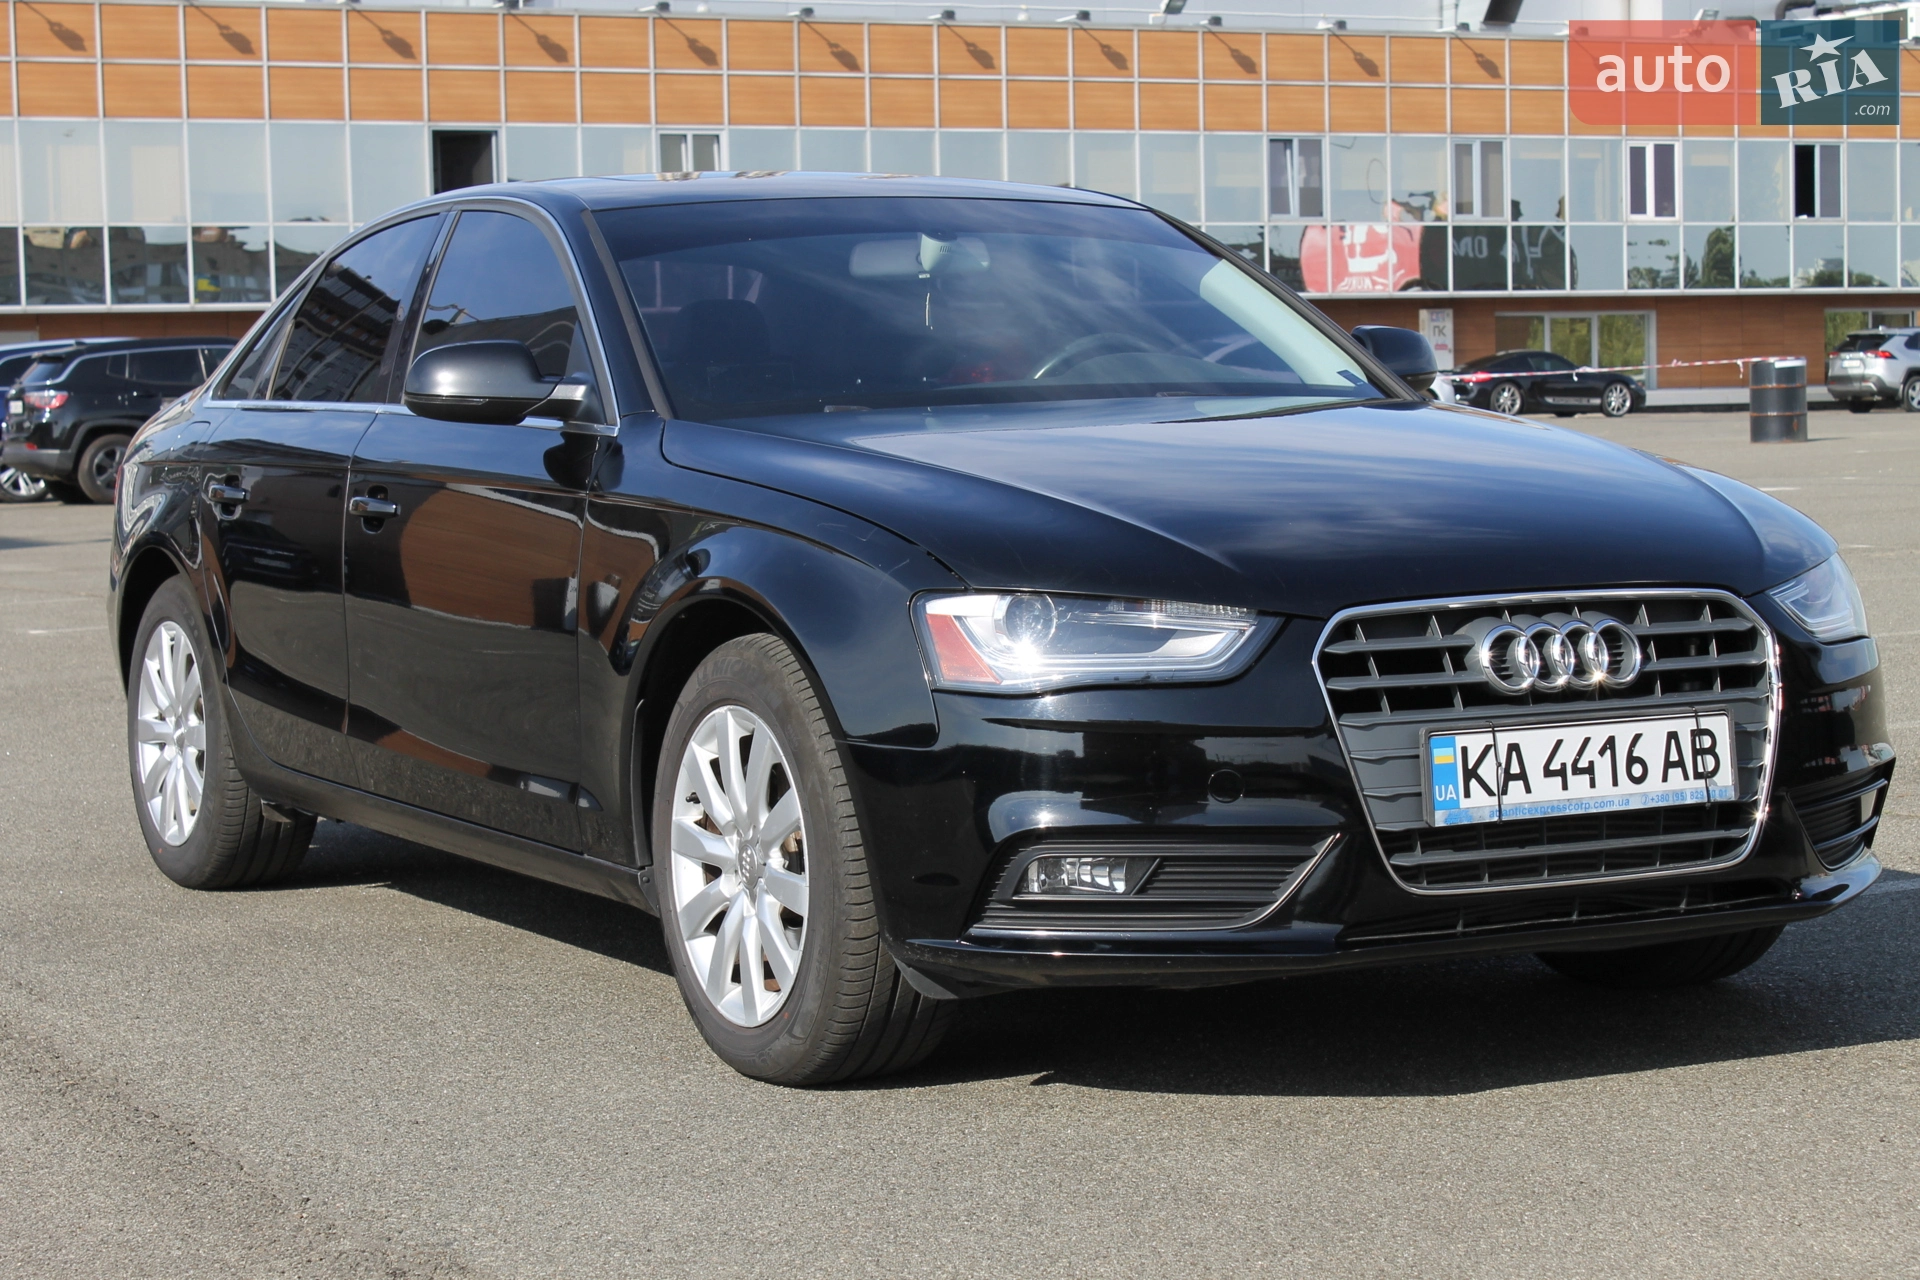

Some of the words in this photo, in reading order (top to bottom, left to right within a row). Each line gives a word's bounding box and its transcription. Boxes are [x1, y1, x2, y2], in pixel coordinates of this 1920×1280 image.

[1461, 742, 1531, 798] KA
[1543, 733, 1648, 791] 4416
[1661, 728, 1721, 783] AB
[1435, 784, 1457, 801] UA
[1488, 797, 1630, 818] atanticexpresscorp.com.ua
